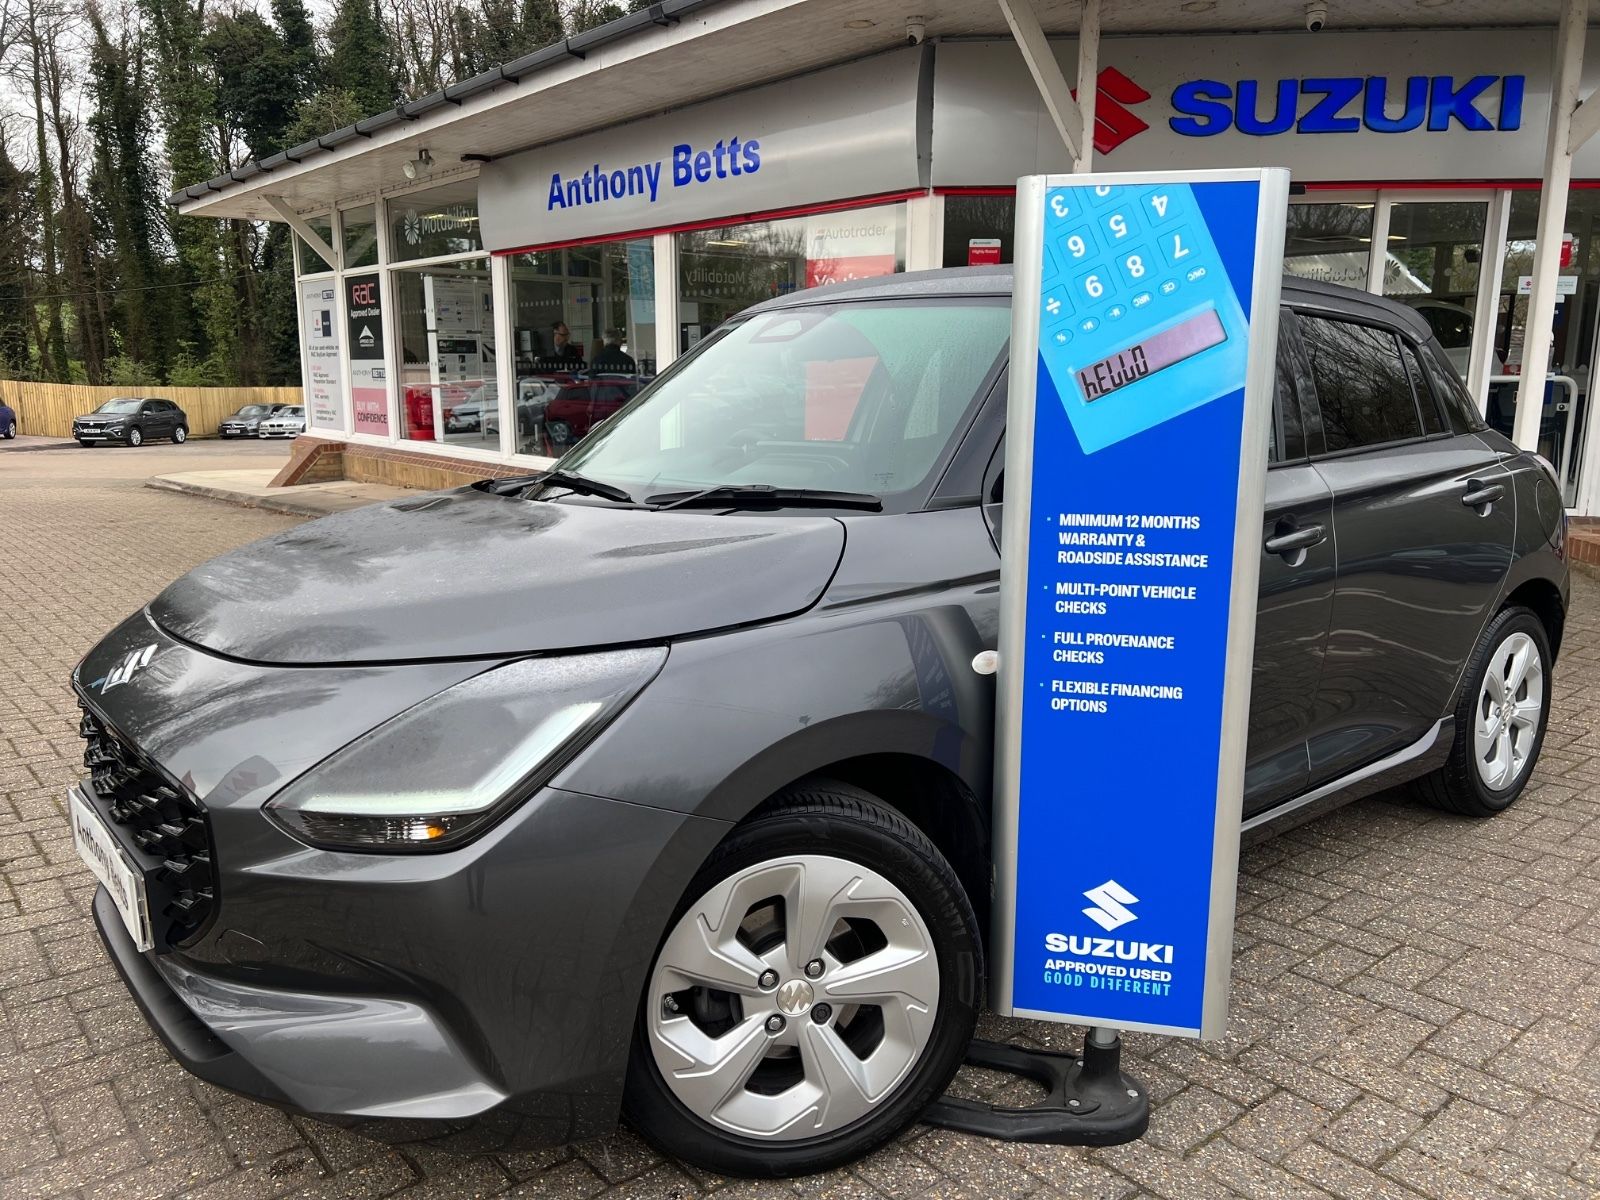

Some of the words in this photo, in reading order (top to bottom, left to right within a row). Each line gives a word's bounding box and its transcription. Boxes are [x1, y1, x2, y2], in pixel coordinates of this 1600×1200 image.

[1169, 75, 1525, 137] SUZUKI
[547, 161, 661, 211] Anthony
[672, 135, 761, 187] Betts
[1151, 194, 1169, 217] 4
[421, 204, 474, 235] Motability
[1109, 214, 1127, 238] 5
[824, 225, 888, 241] Autotrader
[1173, 234, 1190, 259] 7
[1126, 255, 1145, 278] 8
[350, 308, 368, 319] Approved
[368, 307, 380, 317] Dealer
[357, 412, 388, 424] CONFIDENCE
[1059, 513, 1123, 528] MINIMUM
[1125, 514, 1140, 528] 12
[1141, 515, 1201, 530] MONTHS
[1058, 532, 1134, 547] WARRANTY
[1135, 533, 1146, 547] &
[1057, 550, 1123, 565] ROADSIDE
[1124, 552, 1209, 568] ASSISTANCE
[1056, 582, 1140, 598] MULTI-POINT
[1141, 585, 1196, 600] VEHICLE
[1055, 600, 1107, 615] CHECKS
[1054, 631, 1084, 645] FULL
[1085, 632, 1175, 649] PROVENANCE
[1053, 649, 1104, 664] CHECKS
[1051, 679, 1109, 696] FLEXIBLE
[1110, 683, 1183, 700] FINANCING
[1051, 697, 1108, 713] OPTIONS
[76, 814, 110, 880] Anthony
[1044, 932, 1174, 964] SUZUKI
[1044, 958, 1127, 977] APPROVED
[1129, 968, 1172, 982] USED
[1043, 970, 1083, 987] GOOD
[1090, 975, 1171, 996] DIFFERENT
